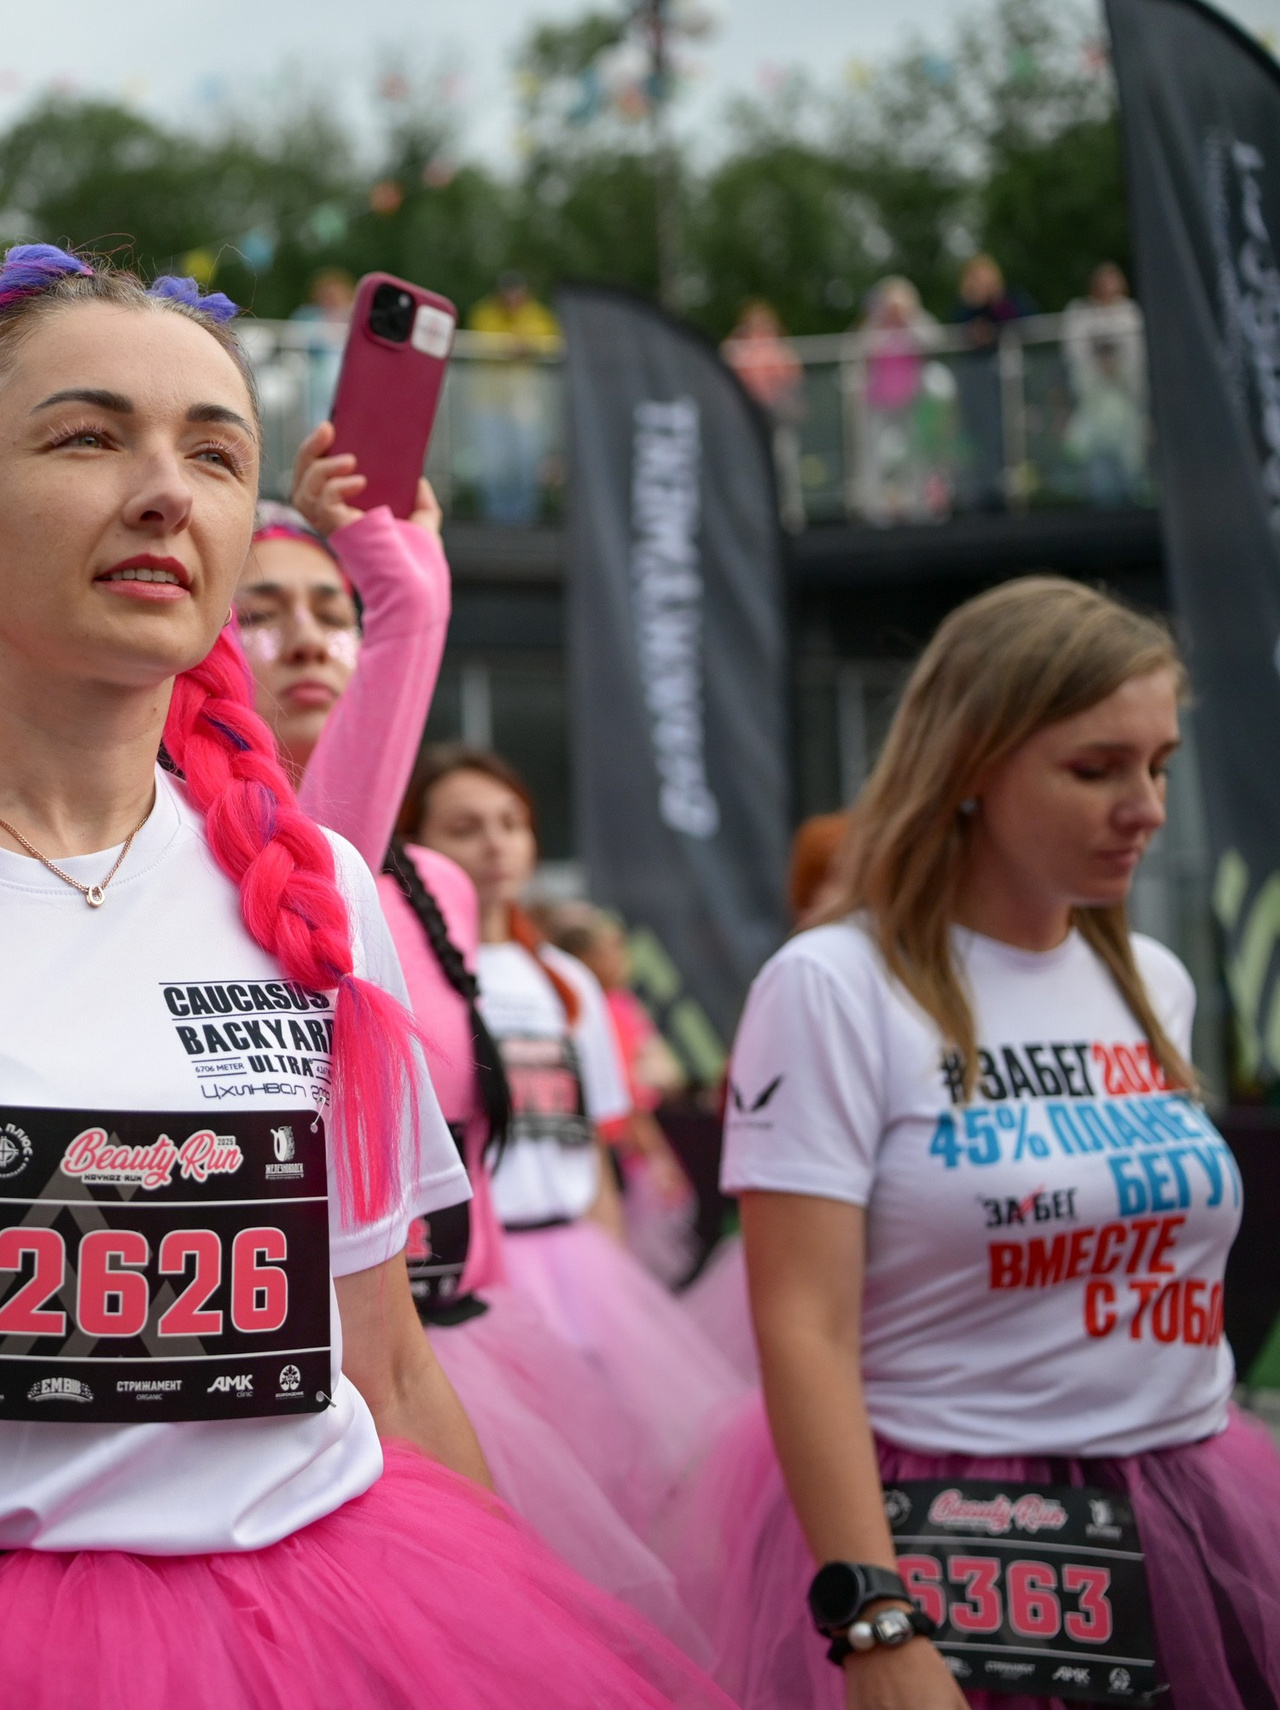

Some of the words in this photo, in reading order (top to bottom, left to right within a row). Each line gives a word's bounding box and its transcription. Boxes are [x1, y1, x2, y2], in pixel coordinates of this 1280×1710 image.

[163, 981, 330, 1017] CAUCASUS
[195, 1065, 215, 1073] 6706
[216, 1062, 245, 1071] METER
[5, 1123, 33, 1155] ПЛЮС
[61, 1128, 177, 1189] Beauty
[178, 1130, 242, 1182] Run
[930, 1100, 1052, 1169] 45%
[988, 1216, 1186, 1290] ВМЕСТЕ
[1084, 1278, 1117, 1339] С
[1129, 1278, 1224, 1347] ТОБО
[116, 1380, 182, 1392] СТРИЖАМЕНТ
[897, 1553, 1114, 1645] 6363
